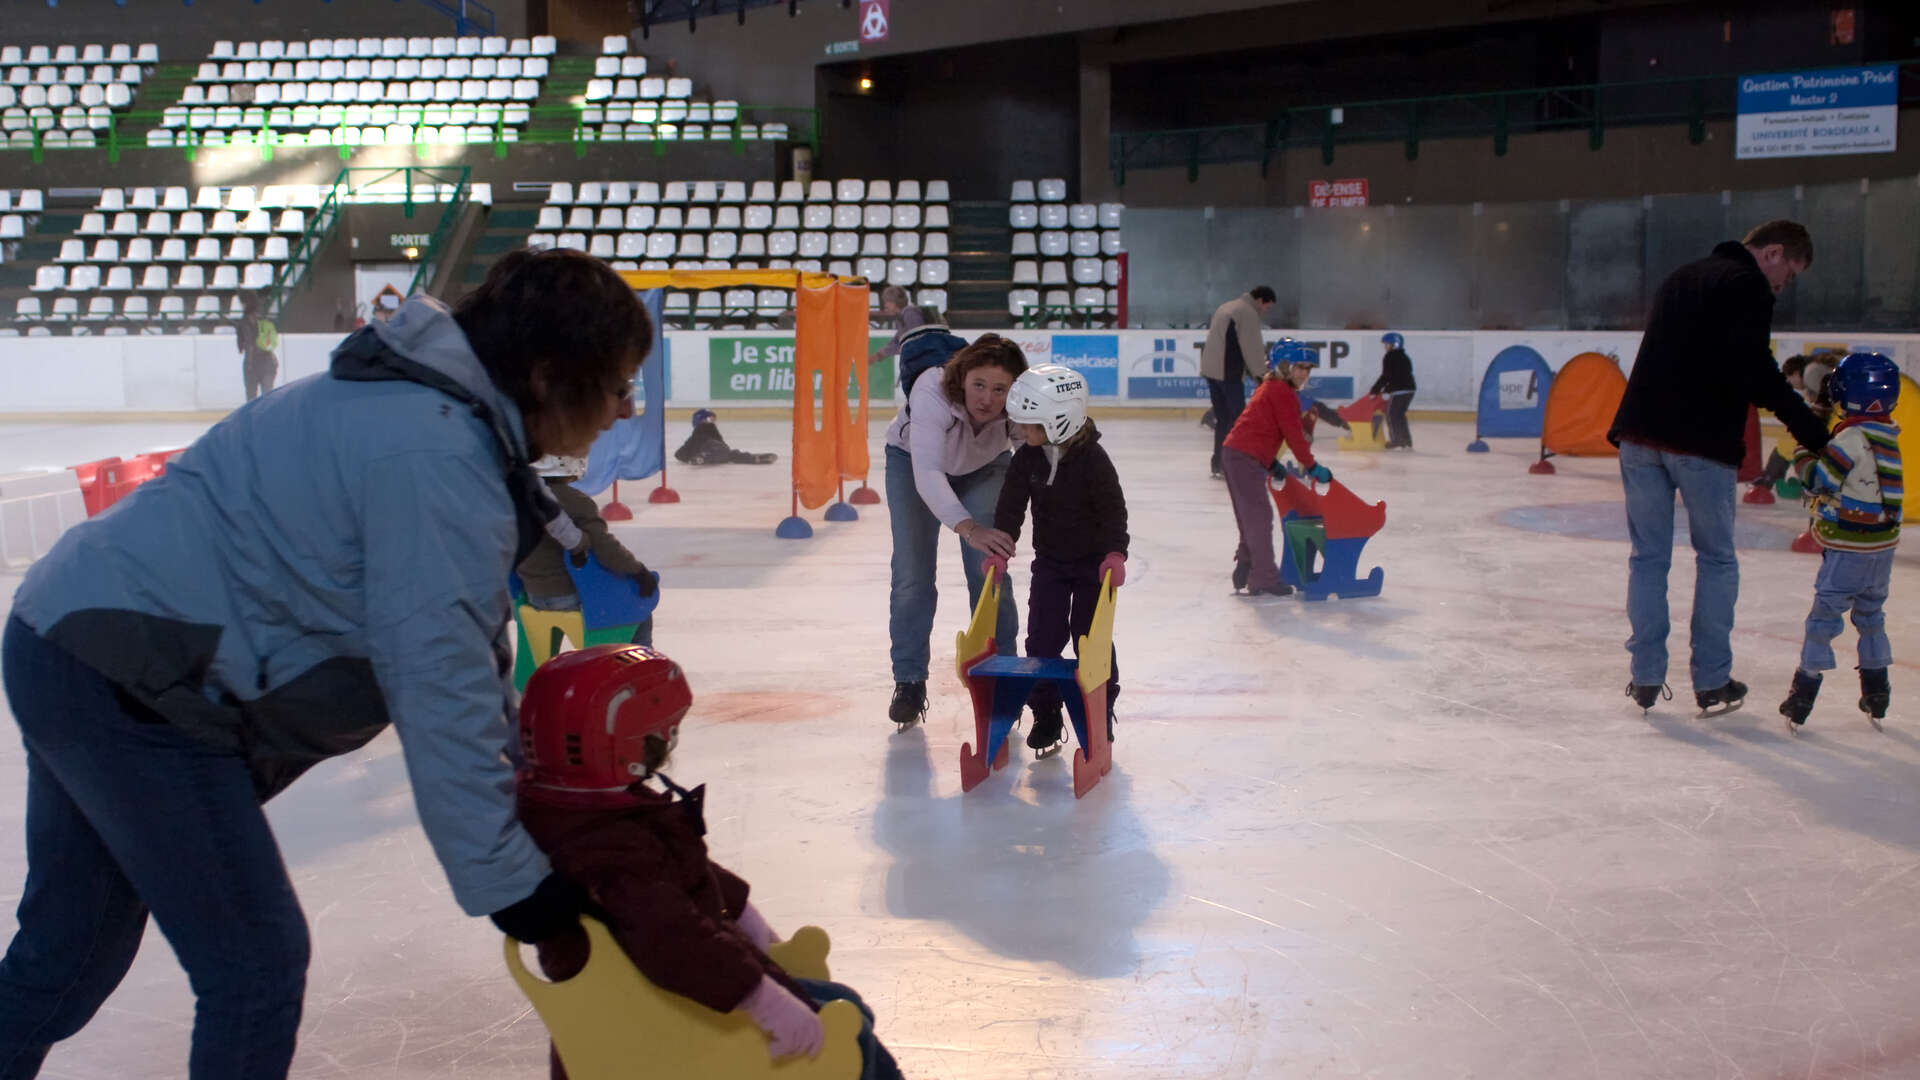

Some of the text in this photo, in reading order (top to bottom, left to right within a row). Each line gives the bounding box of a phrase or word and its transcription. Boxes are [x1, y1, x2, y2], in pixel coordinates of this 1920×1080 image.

[1743, 70, 1895, 92] Gestion Patrimoine Privé
[1790, 92, 1838, 105] Master 2
[1752, 127, 1808, 140] UNIVERSITÉ
[1813, 125, 1870, 138] BORDEAUX
[1312, 198, 1327, 208] DE
[391, 233, 430, 246] SORTIE
[732, 340, 797, 365] Je sm
[1053, 353, 1117, 367] Steelcase
[730, 373, 762, 391] en
[1056, 381, 1082, 393] ITECH
